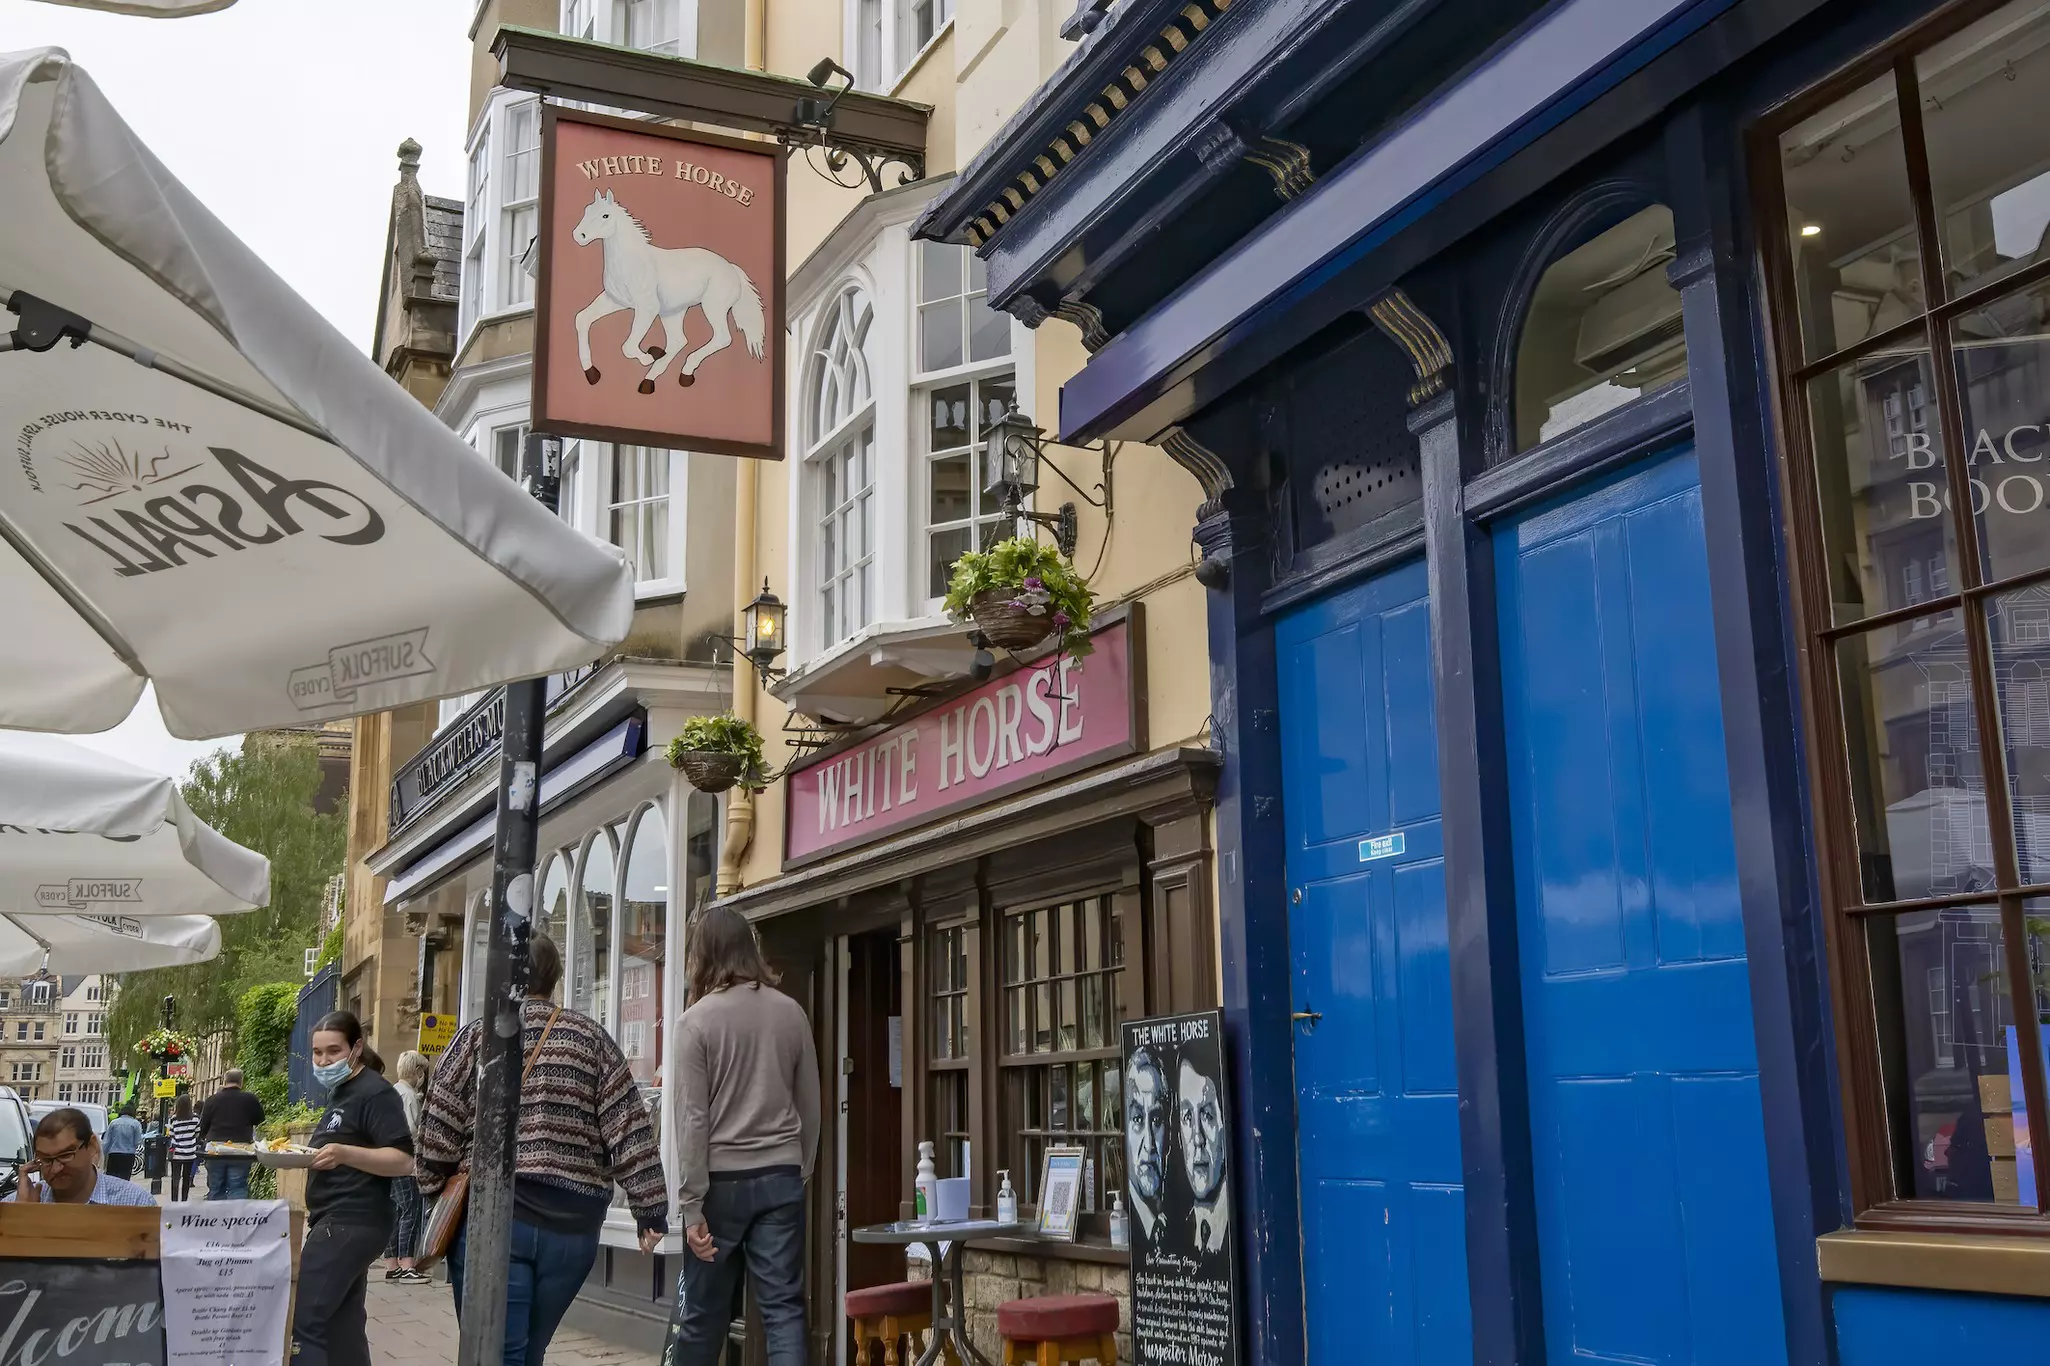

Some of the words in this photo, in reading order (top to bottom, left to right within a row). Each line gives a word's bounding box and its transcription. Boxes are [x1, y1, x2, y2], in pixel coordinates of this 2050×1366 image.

[576, 155, 663, 180] WHITE
[674, 160, 754, 207] HORSE
[1904, 424, 2050, 471] BAC
[1908, 473, 2050, 519] BOO
[816, 728, 920, 835] WHITE
[938, 655, 1084, 792] HORSE
[1132, 1026, 1150, 1046] THE
[1151, 1023, 1177, 1043] WHITE
[1180, 1019, 1209, 1040] HORSE
[181, 1213, 218, 1228] Wine
[196, 1258, 212, 1267] Jug
[214, 1257, 224, 1267] of
[226, 1257, 253, 1266] Pimms
[218, 1268, 234, 1277] £15
